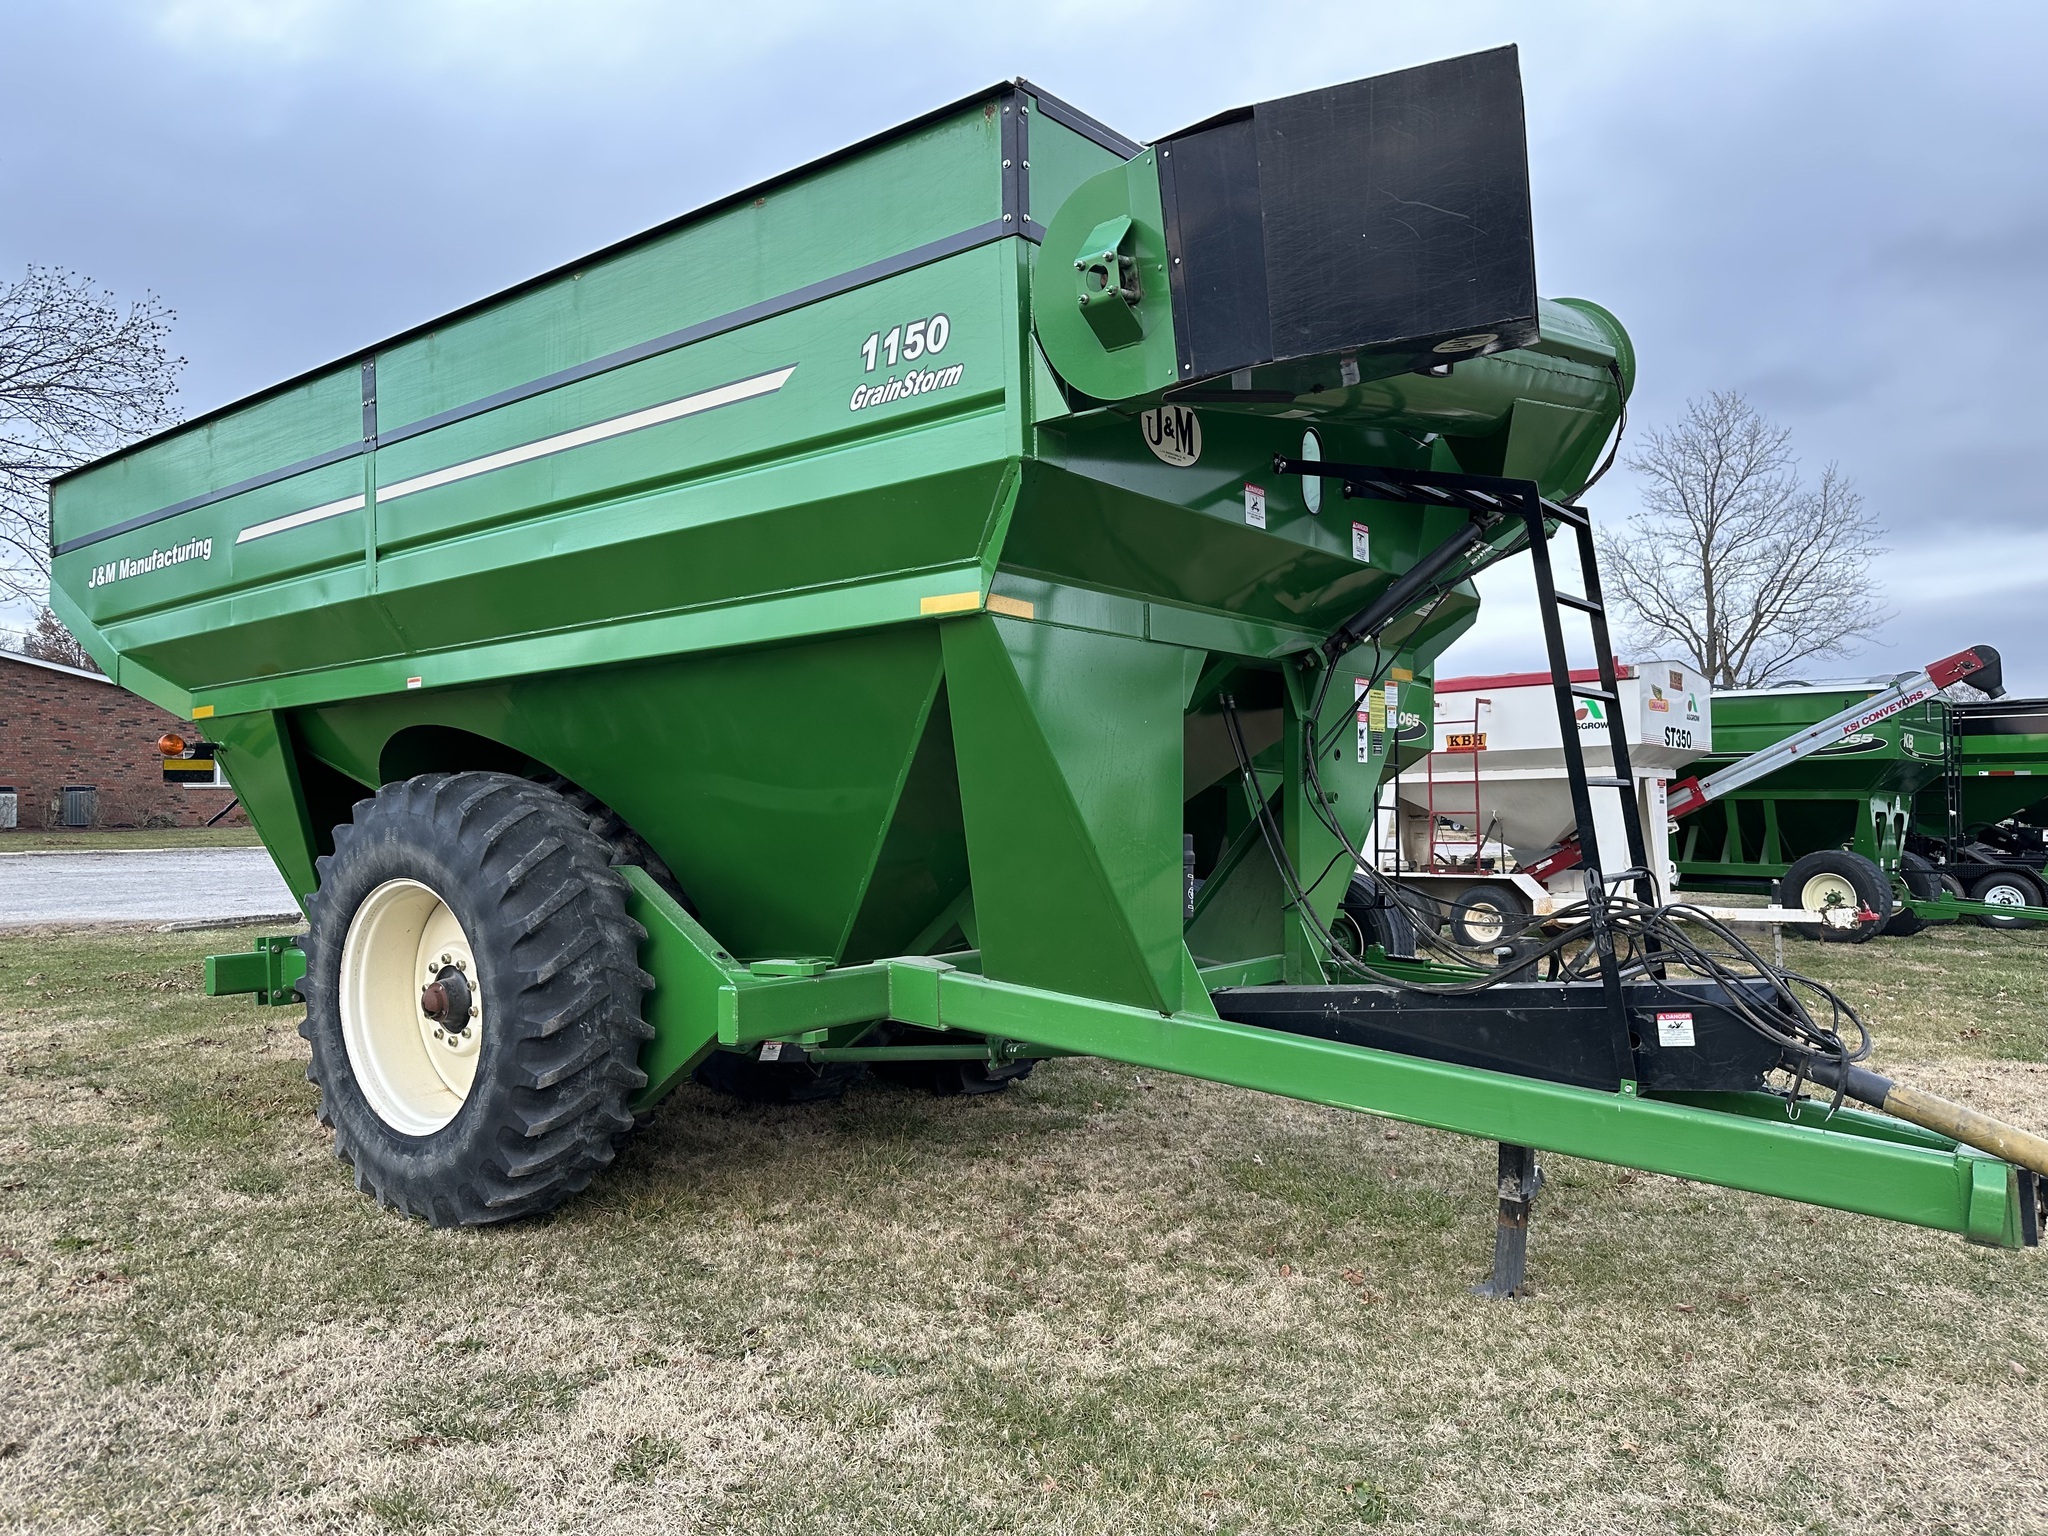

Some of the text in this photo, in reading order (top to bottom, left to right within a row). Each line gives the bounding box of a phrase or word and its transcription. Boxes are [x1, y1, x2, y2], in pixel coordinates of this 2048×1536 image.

[860, 312, 951, 374] 1150
[848, 363, 965, 412] GrainStorm
[1145, 405, 1196, 458] J&M
[88, 537, 213, 589] J&M Manufacturing
[1398, 711, 1420, 727] 065
[1576, 721, 1608, 730] SGROW
[1843, 690, 1925, 735] KSI CONVEYORS
[1449, 734, 1484, 747] KBH
[1664, 726, 1692, 749] ST350
[1903, 732, 1914, 749] KB
